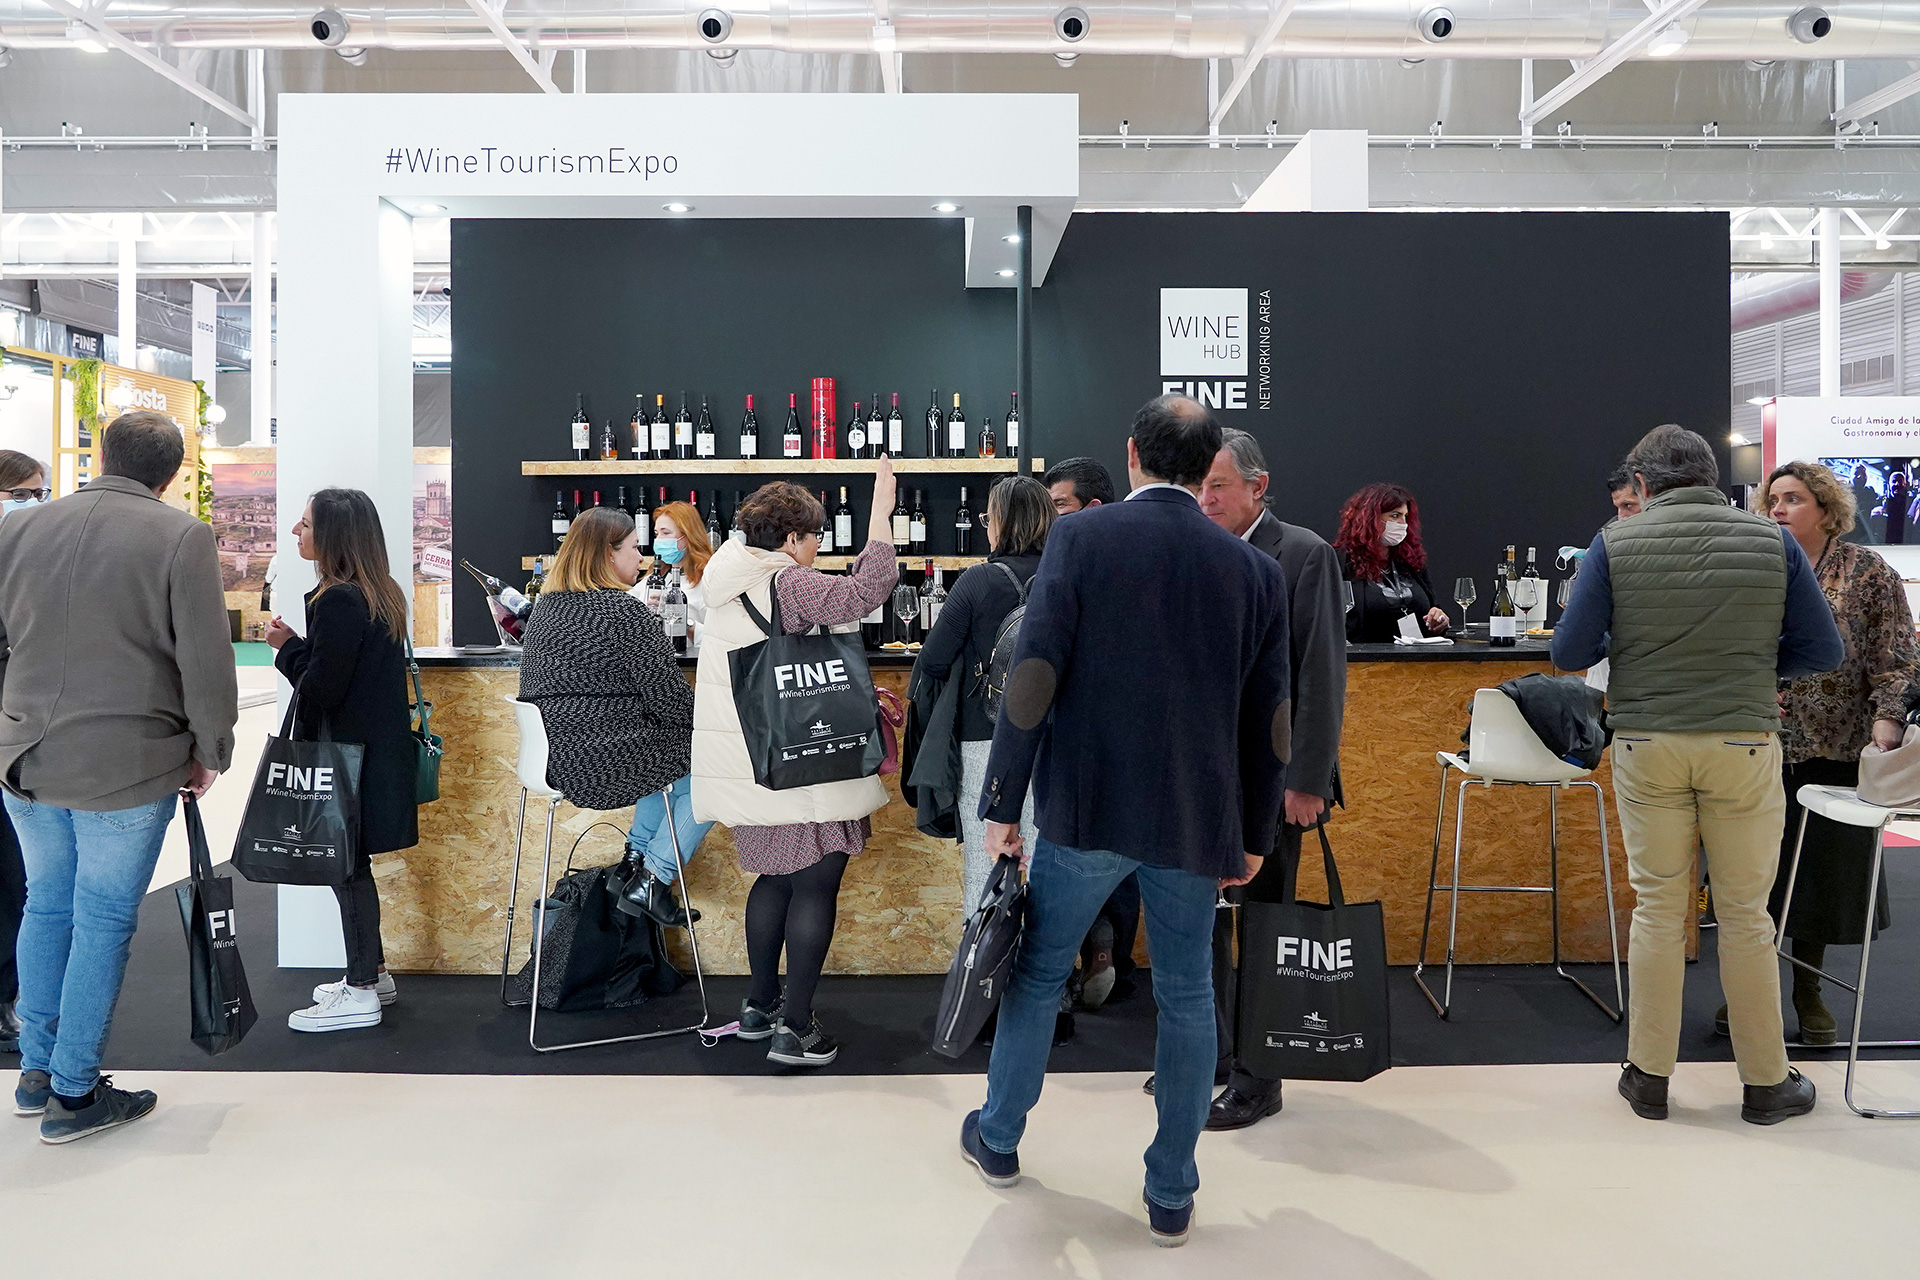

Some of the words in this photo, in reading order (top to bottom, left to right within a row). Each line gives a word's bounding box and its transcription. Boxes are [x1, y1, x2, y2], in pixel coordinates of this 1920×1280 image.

[385, 147, 679, 180] #WineTourismExpo
[1259, 289, 1271, 324] AREA
[1167, 315, 1240, 339] WINE
[72, 333, 98, 353] FINE
[1203, 344, 1241, 360] HUB
[1259, 326, 1271, 410] NETWORKING
[1830, 415, 1863, 425] Ciudad
[1866, 416, 1895, 427] Amiga
[1898, 415, 1910, 425] de
[1905, 430, 1911, 439] y
[425, 553, 452, 567] CERRA
[774, 658, 849, 691] FINE
[778, 683, 851, 699] #WineTourismExpo
[266, 761, 334, 792] FINE
[265, 787, 333, 802] #WineTourismExpo
[1276, 936, 1354, 972] FINE
[1276, 967, 1354, 983] #WineTourismExpo
